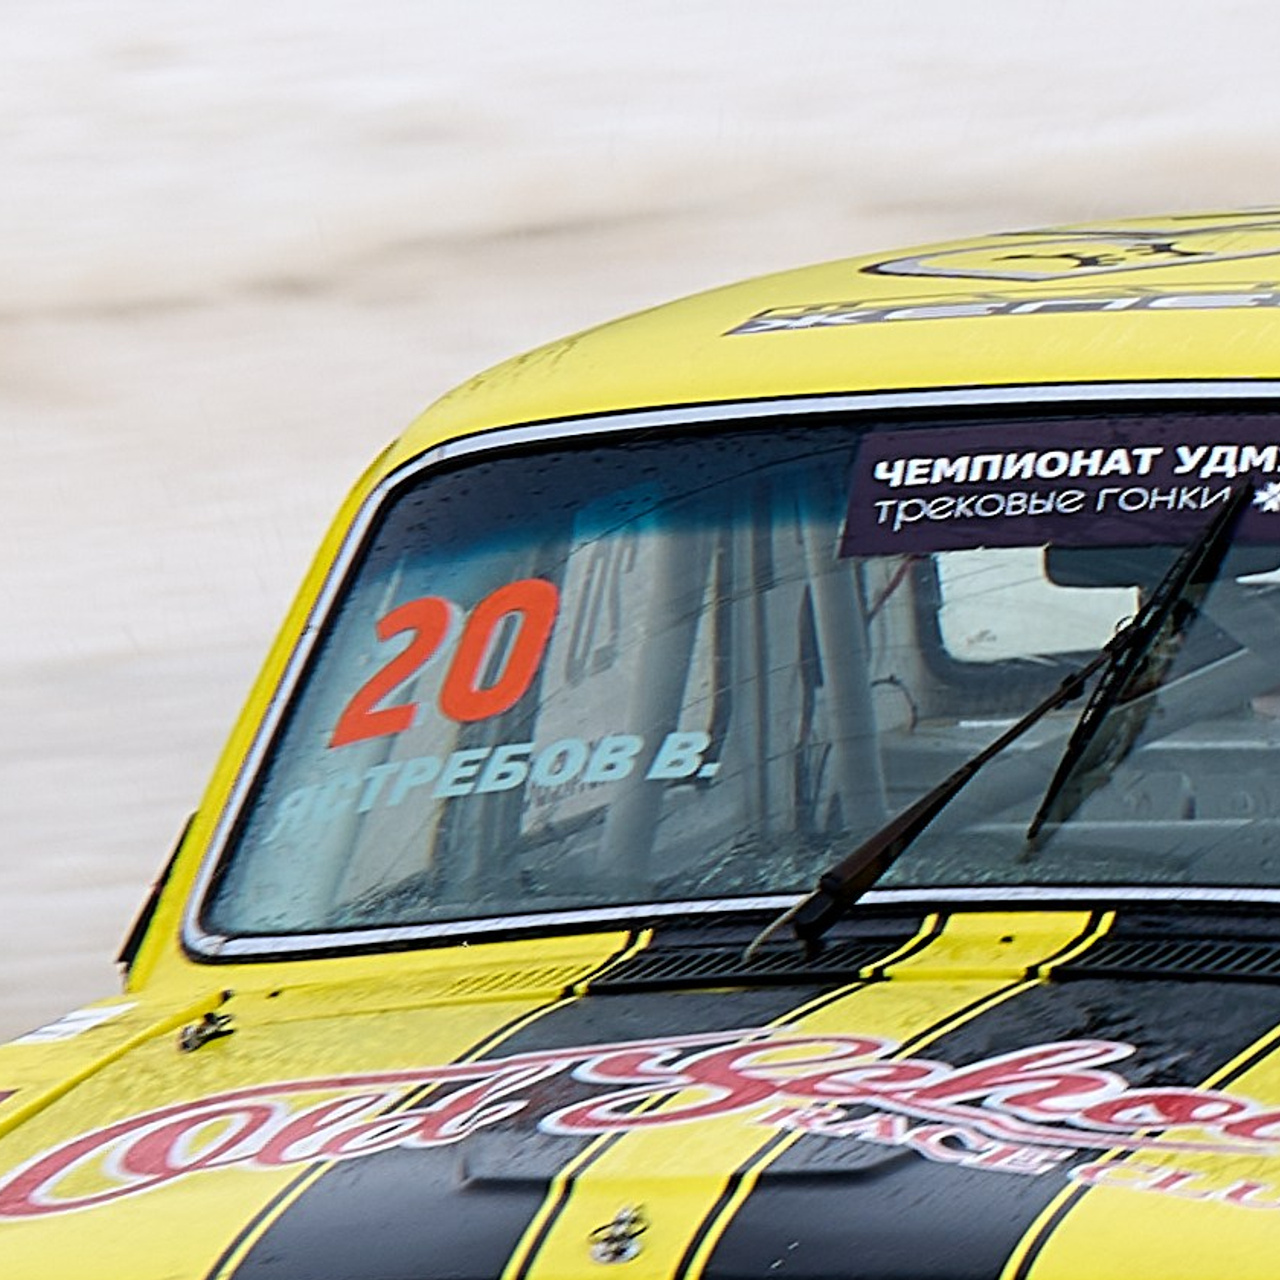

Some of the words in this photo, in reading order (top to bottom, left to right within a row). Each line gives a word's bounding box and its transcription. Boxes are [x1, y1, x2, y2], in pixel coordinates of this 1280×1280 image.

[873, 446, 1162, 488] ЧЕМПИОНАТ
[329, 577, 561, 749] 20
[645, 731, 721, 781] В.
[0, 1048, 620, 1218] Old
[752, 1104, 1077, 1176] RACE
